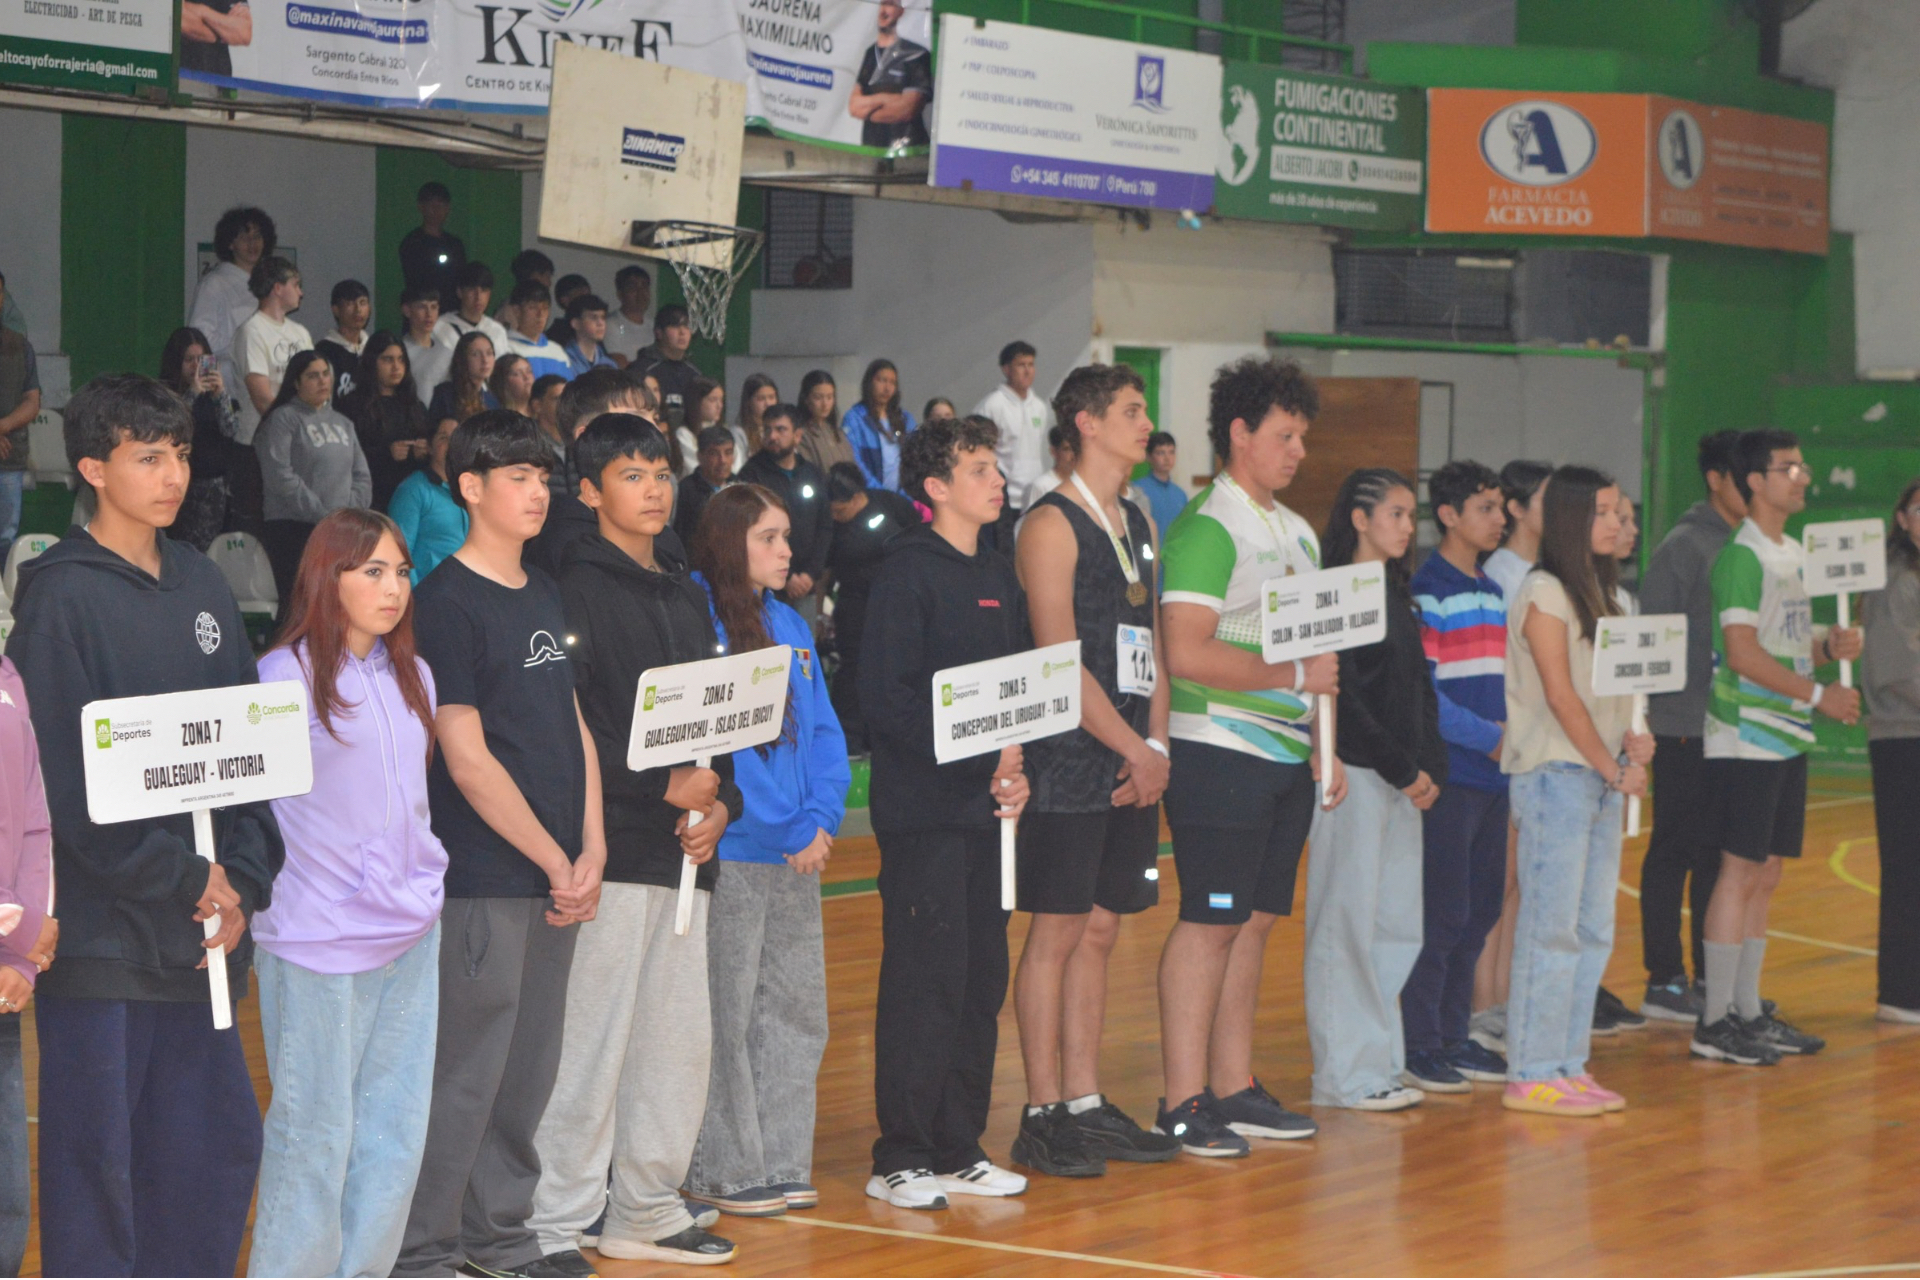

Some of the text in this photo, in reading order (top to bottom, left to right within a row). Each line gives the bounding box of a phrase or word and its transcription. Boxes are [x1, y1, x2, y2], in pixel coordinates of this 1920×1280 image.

[24, 0, 78, 19] ELECTRICIDAD
[106, 12, 117, 24] DE
[119, 14, 143, 27] PESCA
[306, 45, 356, 63] Sargento
[359, 52, 386, 67] Cabral
[312, 66, 358, 81] Concordia
[1275, 78, 1398, 122] FUMIGACIONES
[1273, 111, 1386, 153] CONTINENTAL
[1274, 154, 1312, 175] ALBERTO
[1488, 186, 1590, 205] FARMACIA
[1485, 204, 1593, 227] ACEVEDO
[307, 422, 349, 448] GAP
[1316, 589, 1339, 610] ZONA 4
[1271, 626, 1293, 645] COLON
[1298, 622, 1311, 640] SAN
[1313, 616, 1343, 637] SALVADOR
[1348, 609, 1379, 630] VILLAGUAY
[655, 692, 683, 705] Deportes
[702, 682, 734, 707] ZONA 6
[952, 687, 979, 701] Deportes
[999, 677, 1026, 700] ZONA 5
[644, 719, 709, 749] GUALEGUAYCHU
[714, 713, 737, 735] ISLAS
[738, 711, 750, 730] DEL
[751, 703, 774, 726] IBICUY
[951, 714, 998, 741] CONCEPCION
[1000, 711, 1013, 729] DEL
[1015, 701, 1046, 725] URUGUAY
[1053, 696, 1069, 716] TALA
[112, 729, 151, 742] Deportes
[181, 719, 222, 746] ZONA 7
[144, 761, 206, 790] GUALEGUAY
[217, 754, 265, 781] VICTORIA
